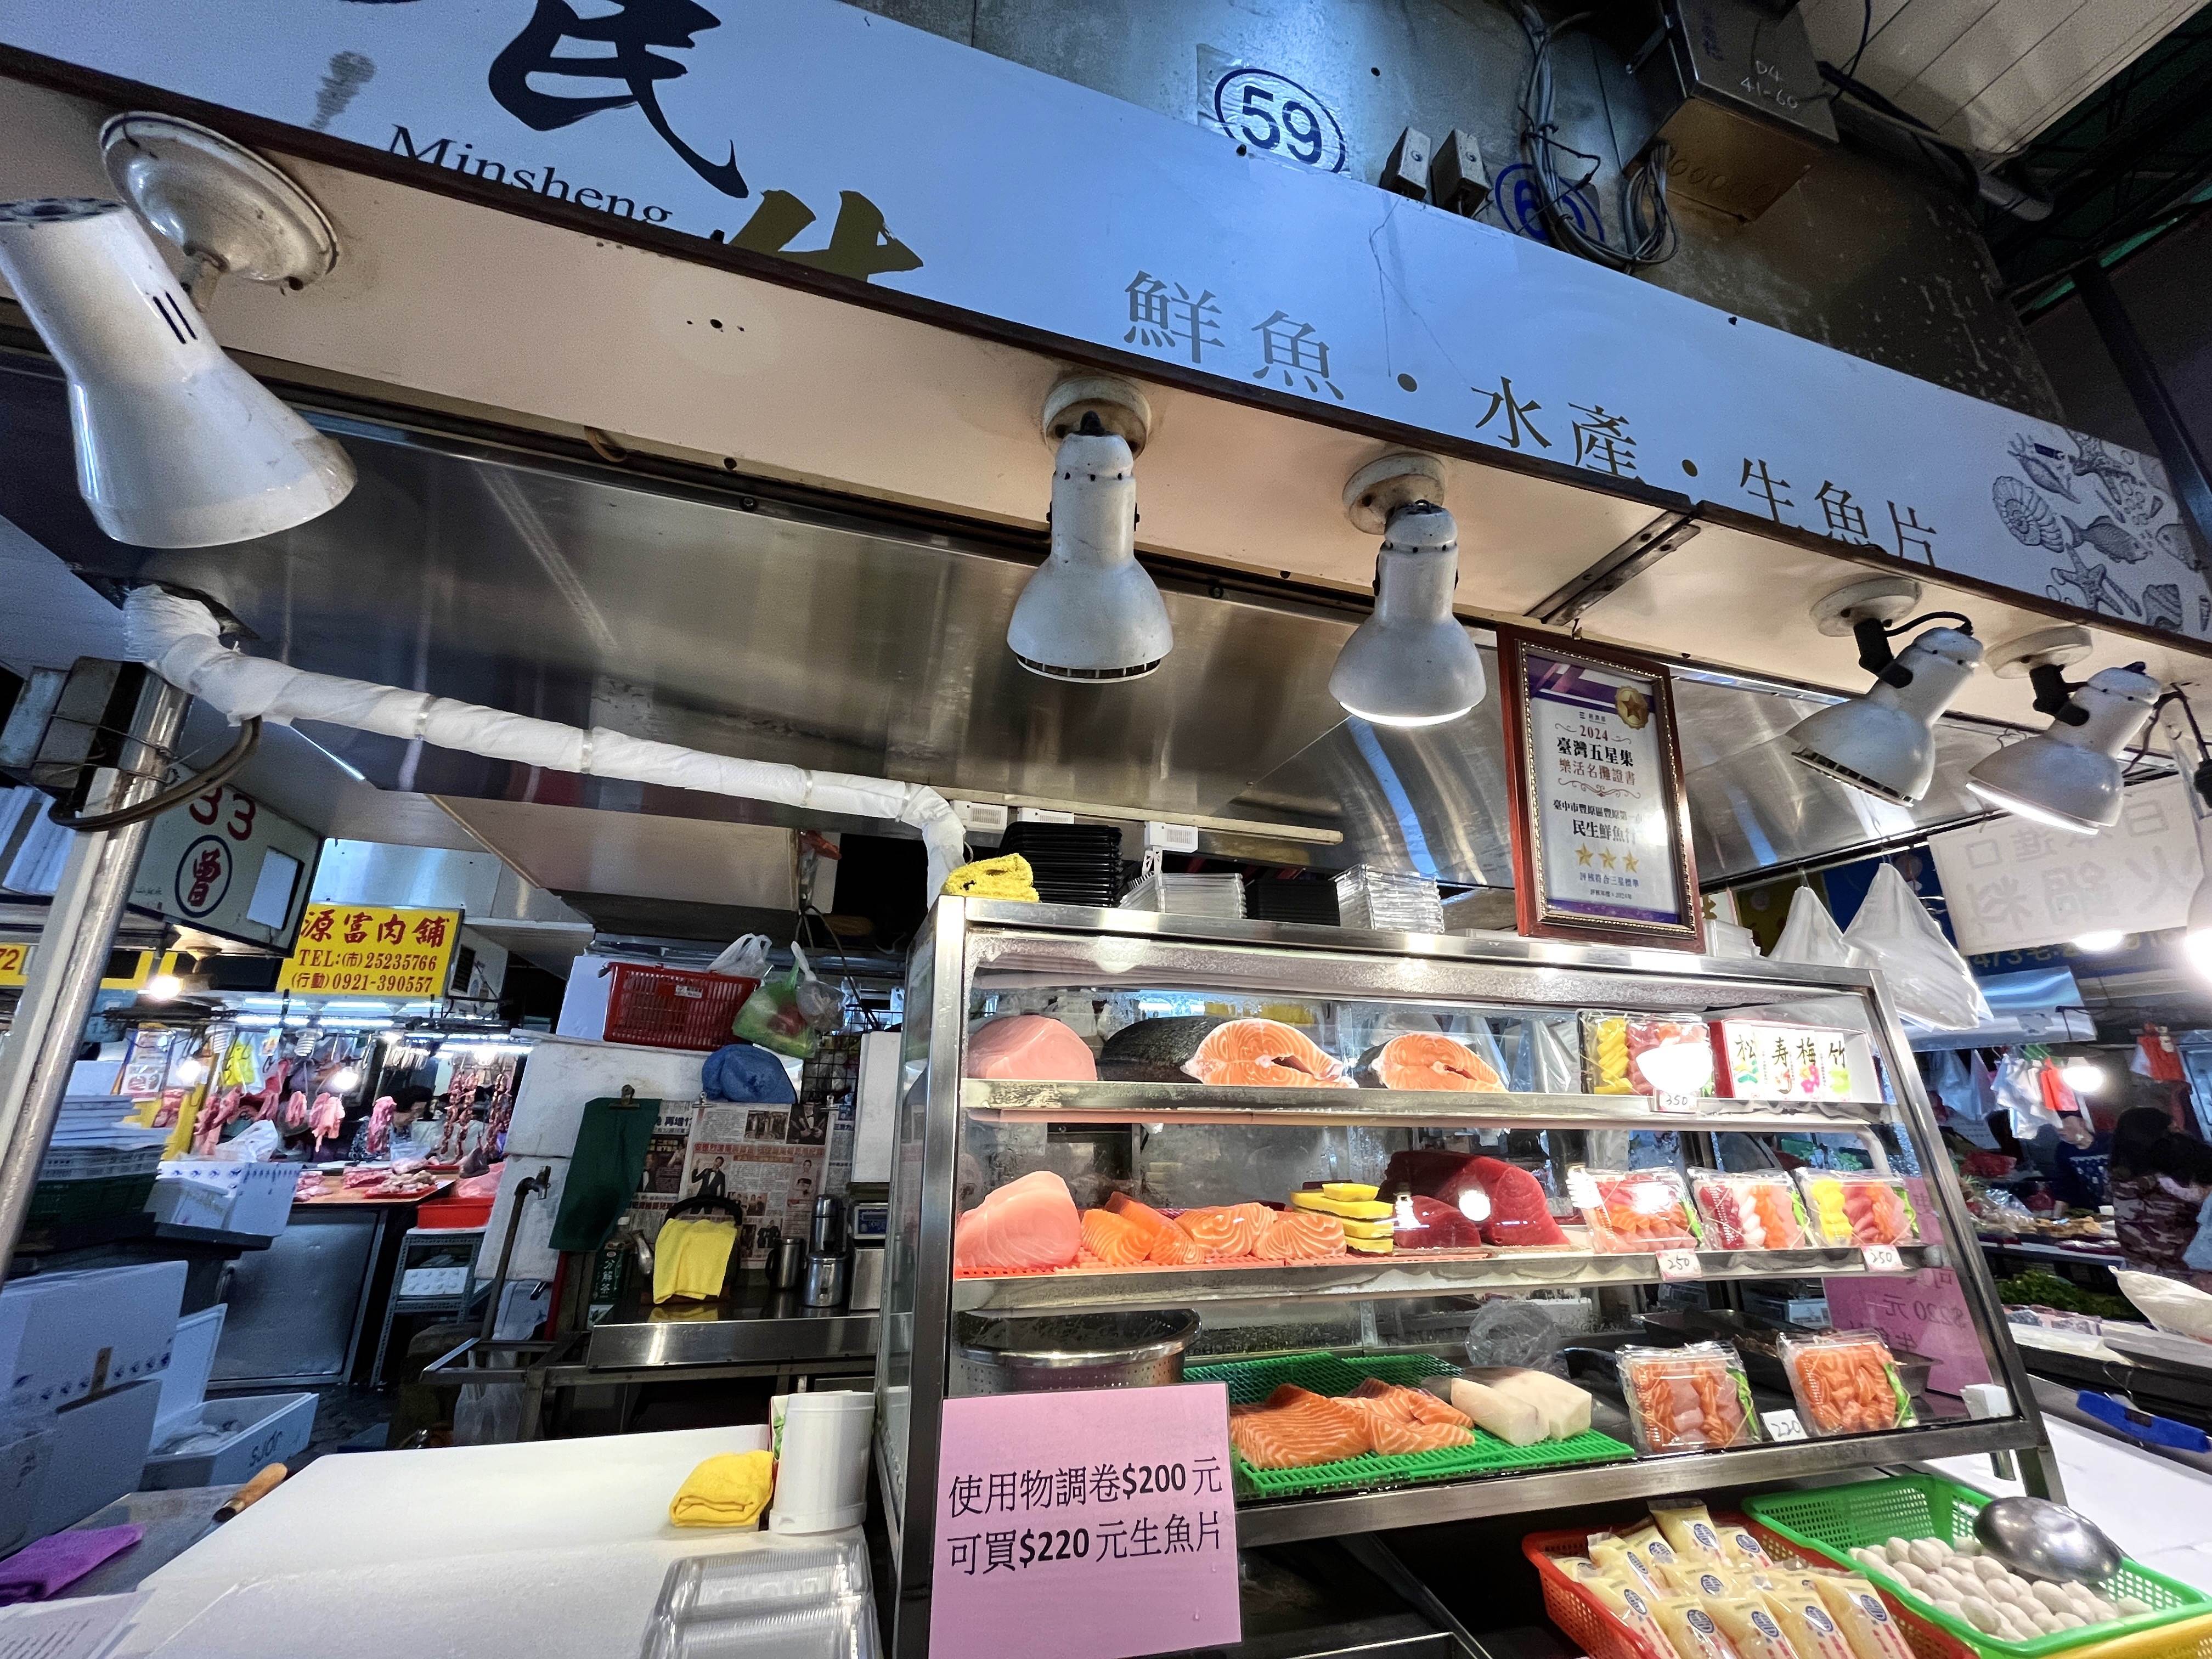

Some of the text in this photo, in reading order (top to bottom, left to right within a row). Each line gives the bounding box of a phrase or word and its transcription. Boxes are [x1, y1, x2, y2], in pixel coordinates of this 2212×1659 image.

[1240, 85, 1322, 164] 59
[1579, 725, 1609, 741] 2024
[1557, 737, 1634, 767] 臺灣五星集
[1735, 1034, 1756, 1062] 松
[1828, 1040, 1846, 1069] 竹
[1666, 1094, 1688, 1105] 350
[1667, 1255, 1690, 1271] 250
[1870, 1250, 1892, 1264] 250
[1770, 1420, 1801, 1437] 220
